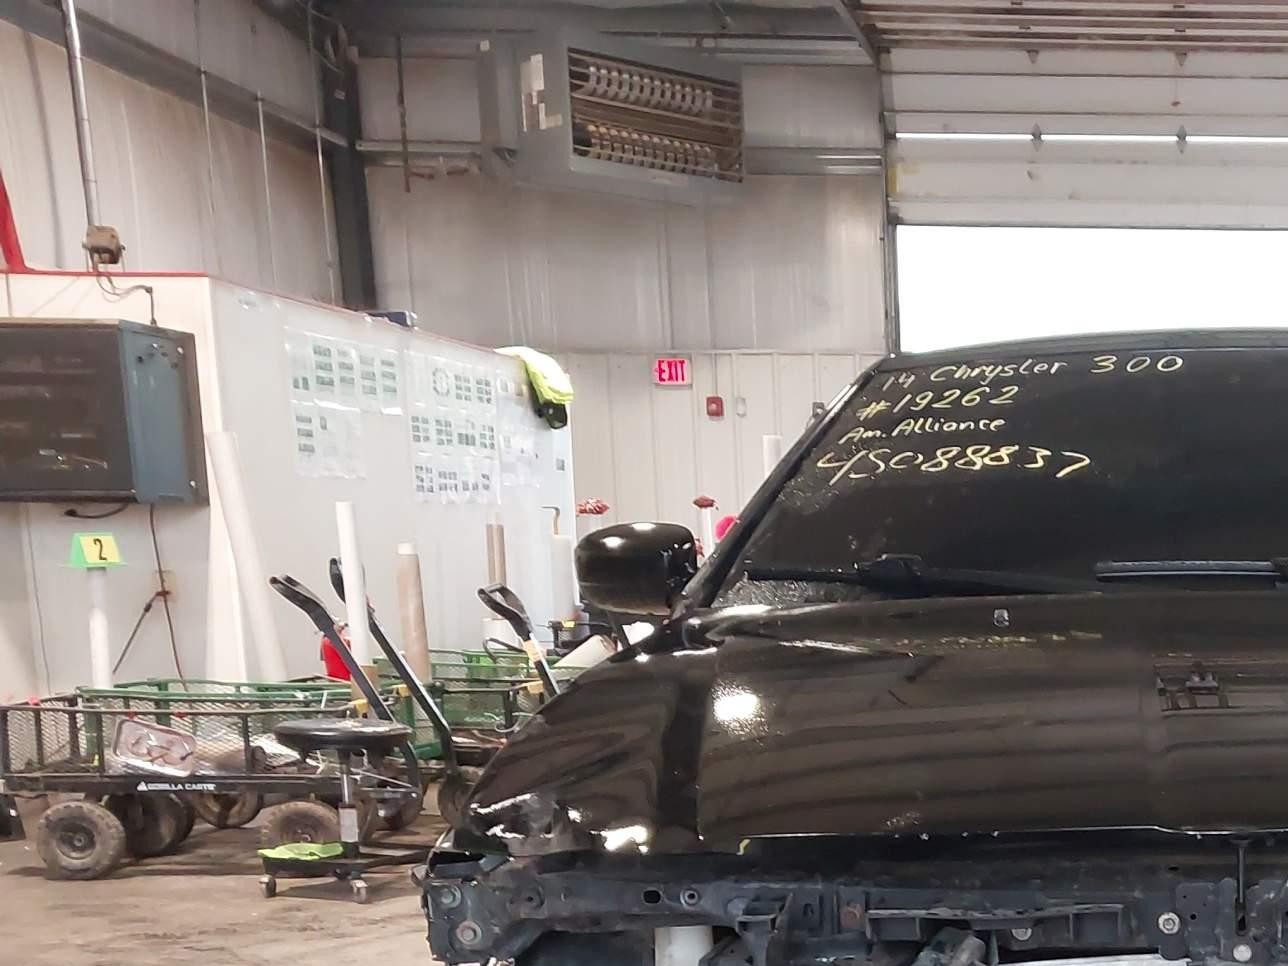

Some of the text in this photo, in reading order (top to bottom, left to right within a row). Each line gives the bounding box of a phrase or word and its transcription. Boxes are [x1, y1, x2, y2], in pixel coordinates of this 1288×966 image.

[657, 359, 686, 382] EXIT
[930, 358, 1068, 386] Chrysler
[1090, 355, 1184, 373] 300
[855, 385, 1019, 421] #19262
[892, 417, 1007, 437] Alliance
[816, 444, 1091, 486] 45088837
[93, 537, 108, 561] 2
